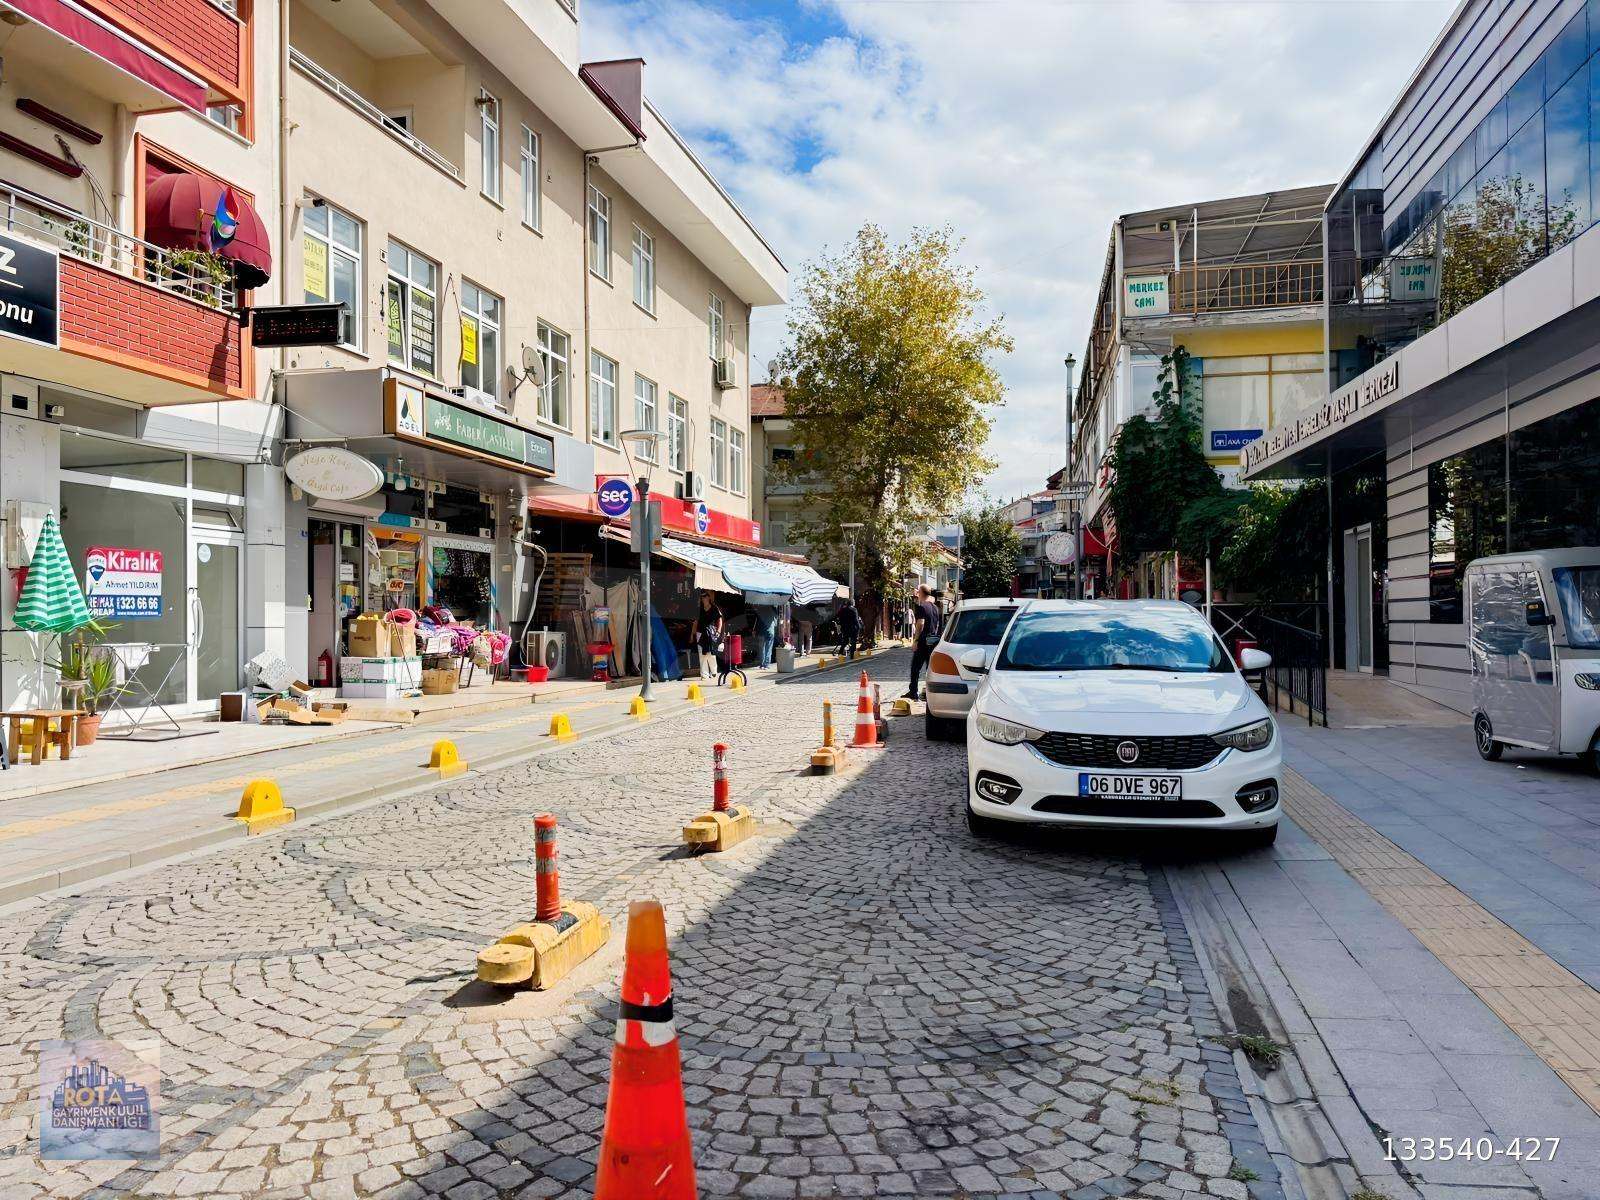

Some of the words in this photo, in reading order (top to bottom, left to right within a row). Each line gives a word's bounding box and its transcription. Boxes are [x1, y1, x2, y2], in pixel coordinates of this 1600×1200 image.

[1129, 282, 1164, 293] MERKEZ
[1331, 390, 1359, 423] YAŞAM
[399, 420, 420, 434] ADEL
[601, 490, 629, 504] seç
[108, 551, 159, 572] Kiralık
[105, 580, 128, 589] Ahmet
[129, 581, 159, 590] YILDIRIM
[120, 597, 136, 610] 323
[137, 597, 147, 610] 66
[149, 597, 159, 610] 66
[1089, 777, 1109, 793] 06
[1114, 777, 1144, 793] DVE
[1149, 778, 1179, 795] 967
